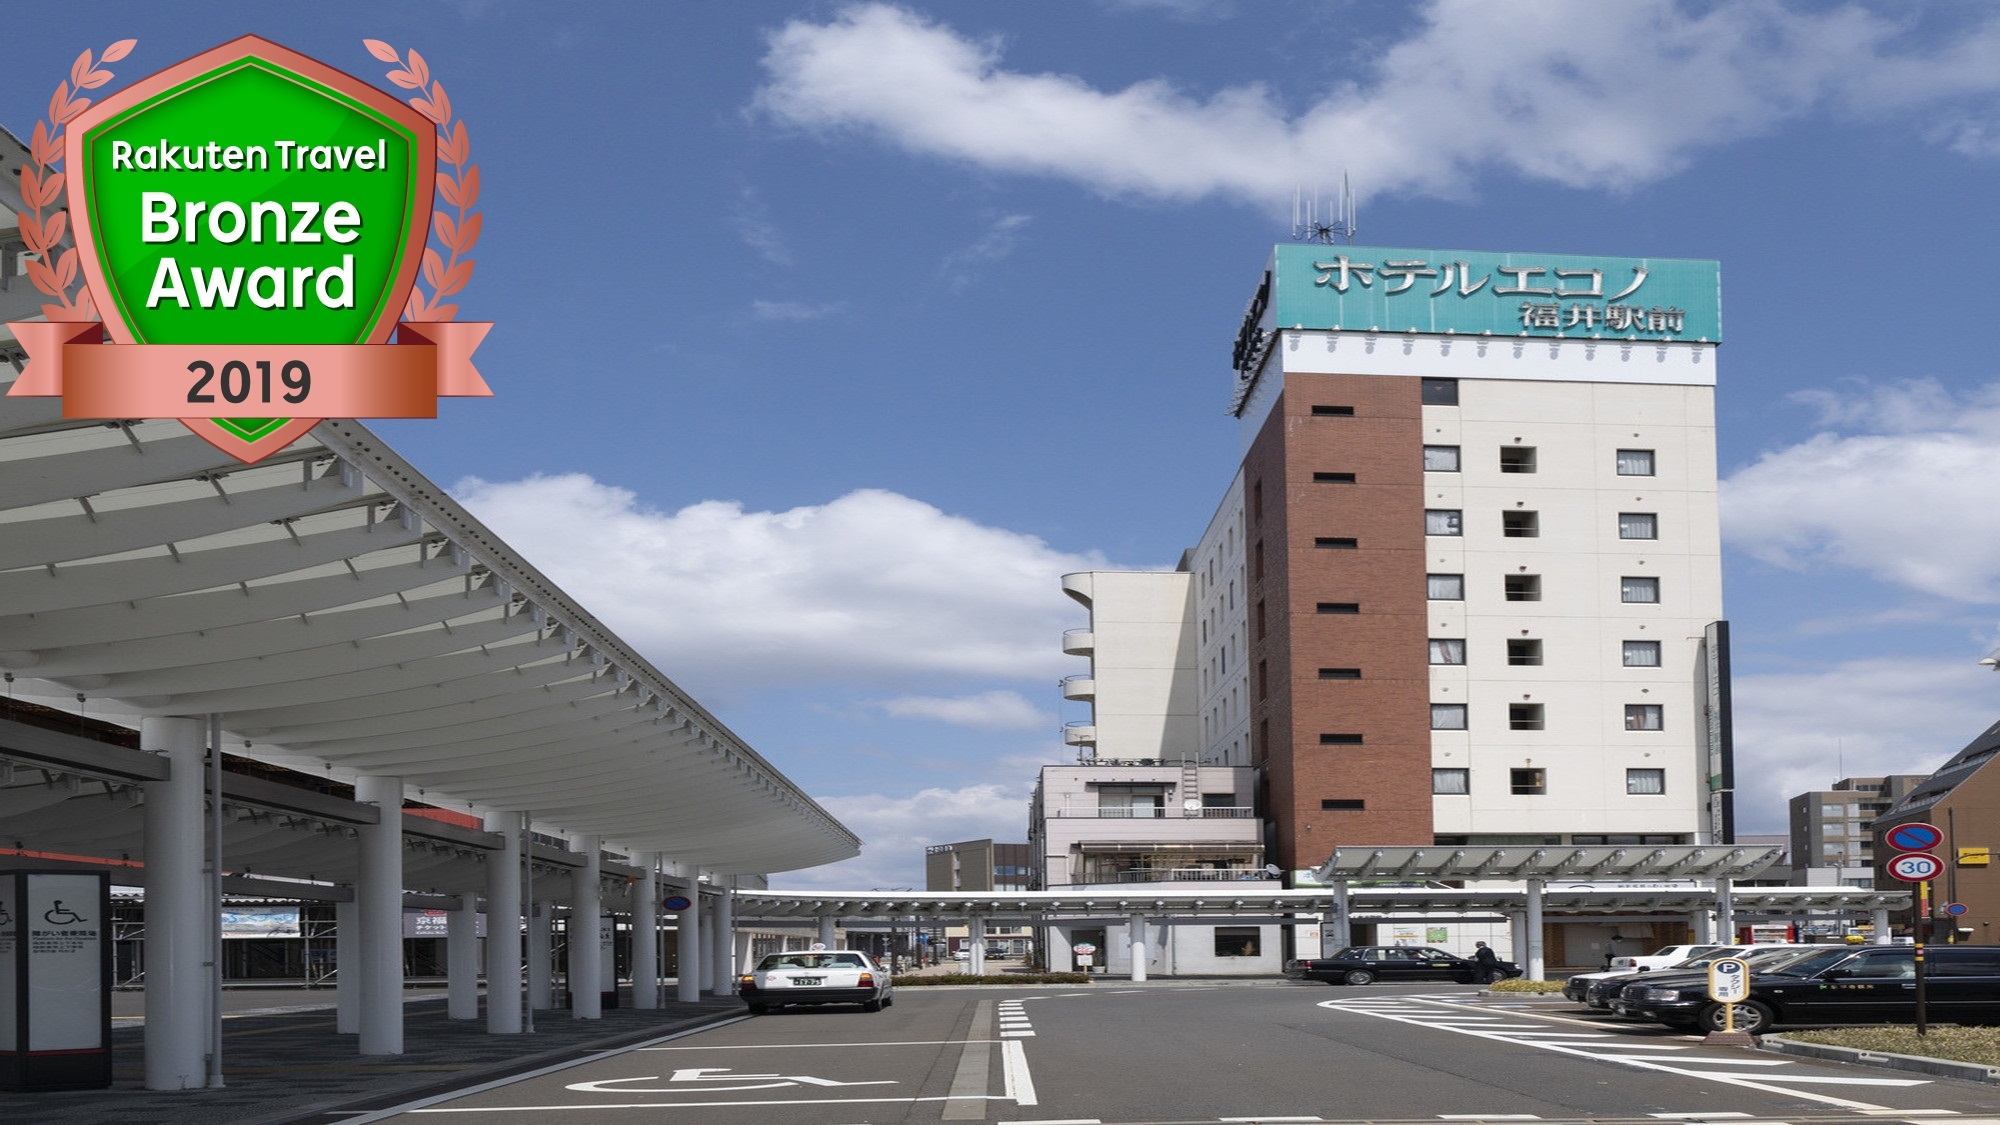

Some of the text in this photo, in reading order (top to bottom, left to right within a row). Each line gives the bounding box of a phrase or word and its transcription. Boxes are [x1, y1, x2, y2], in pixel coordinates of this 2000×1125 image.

[1313, 254, 1649, 301] ホテルエコノ
[1518, 301, 1686, 332] 福井駅前
[1901, 861, 1932, 875] 30
[1722, 963, 1736, 973] P
